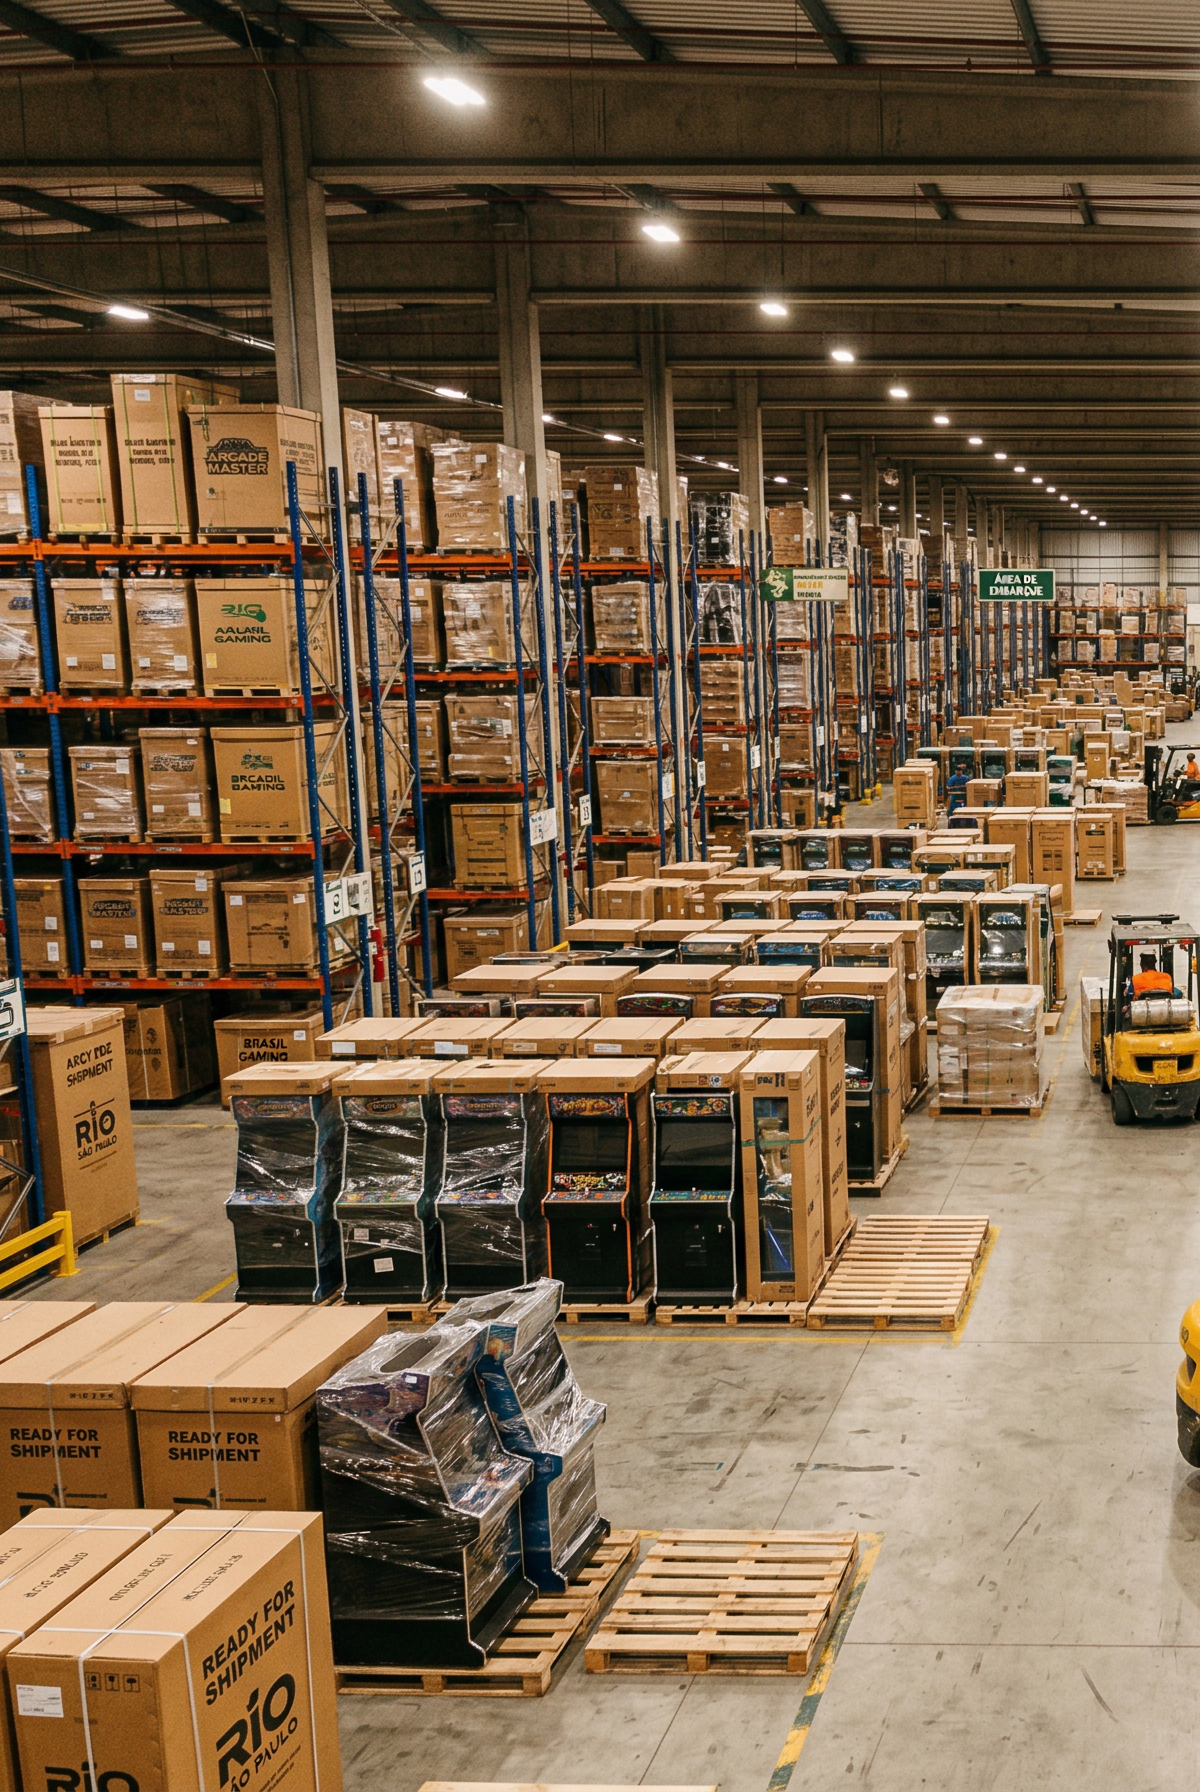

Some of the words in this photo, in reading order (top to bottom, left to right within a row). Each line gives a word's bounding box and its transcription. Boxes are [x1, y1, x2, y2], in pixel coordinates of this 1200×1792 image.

[207, 463, 268, 474] MASTER
[1023, 574, 1038, 584] DE
[214, 635, 272, 643] GAMING
[10, 1428, 62, 1441] READY
[67, 1429, 99, 1442] FOR
[168, 1431, 222, 1444] READY
[227, 1432, 259, 1445] FOR
[10, 1444, 102, 1459] SHIPMENT
[168, 1447, 261, 1462] SHIPMENT
[202, 1611, 258, 1681] READY
[263, 1580, 295, 1623] FOR
[206, 1604, 295, 1706] SHIPMENT
[254, 1716, 298, 1774] PAULO
